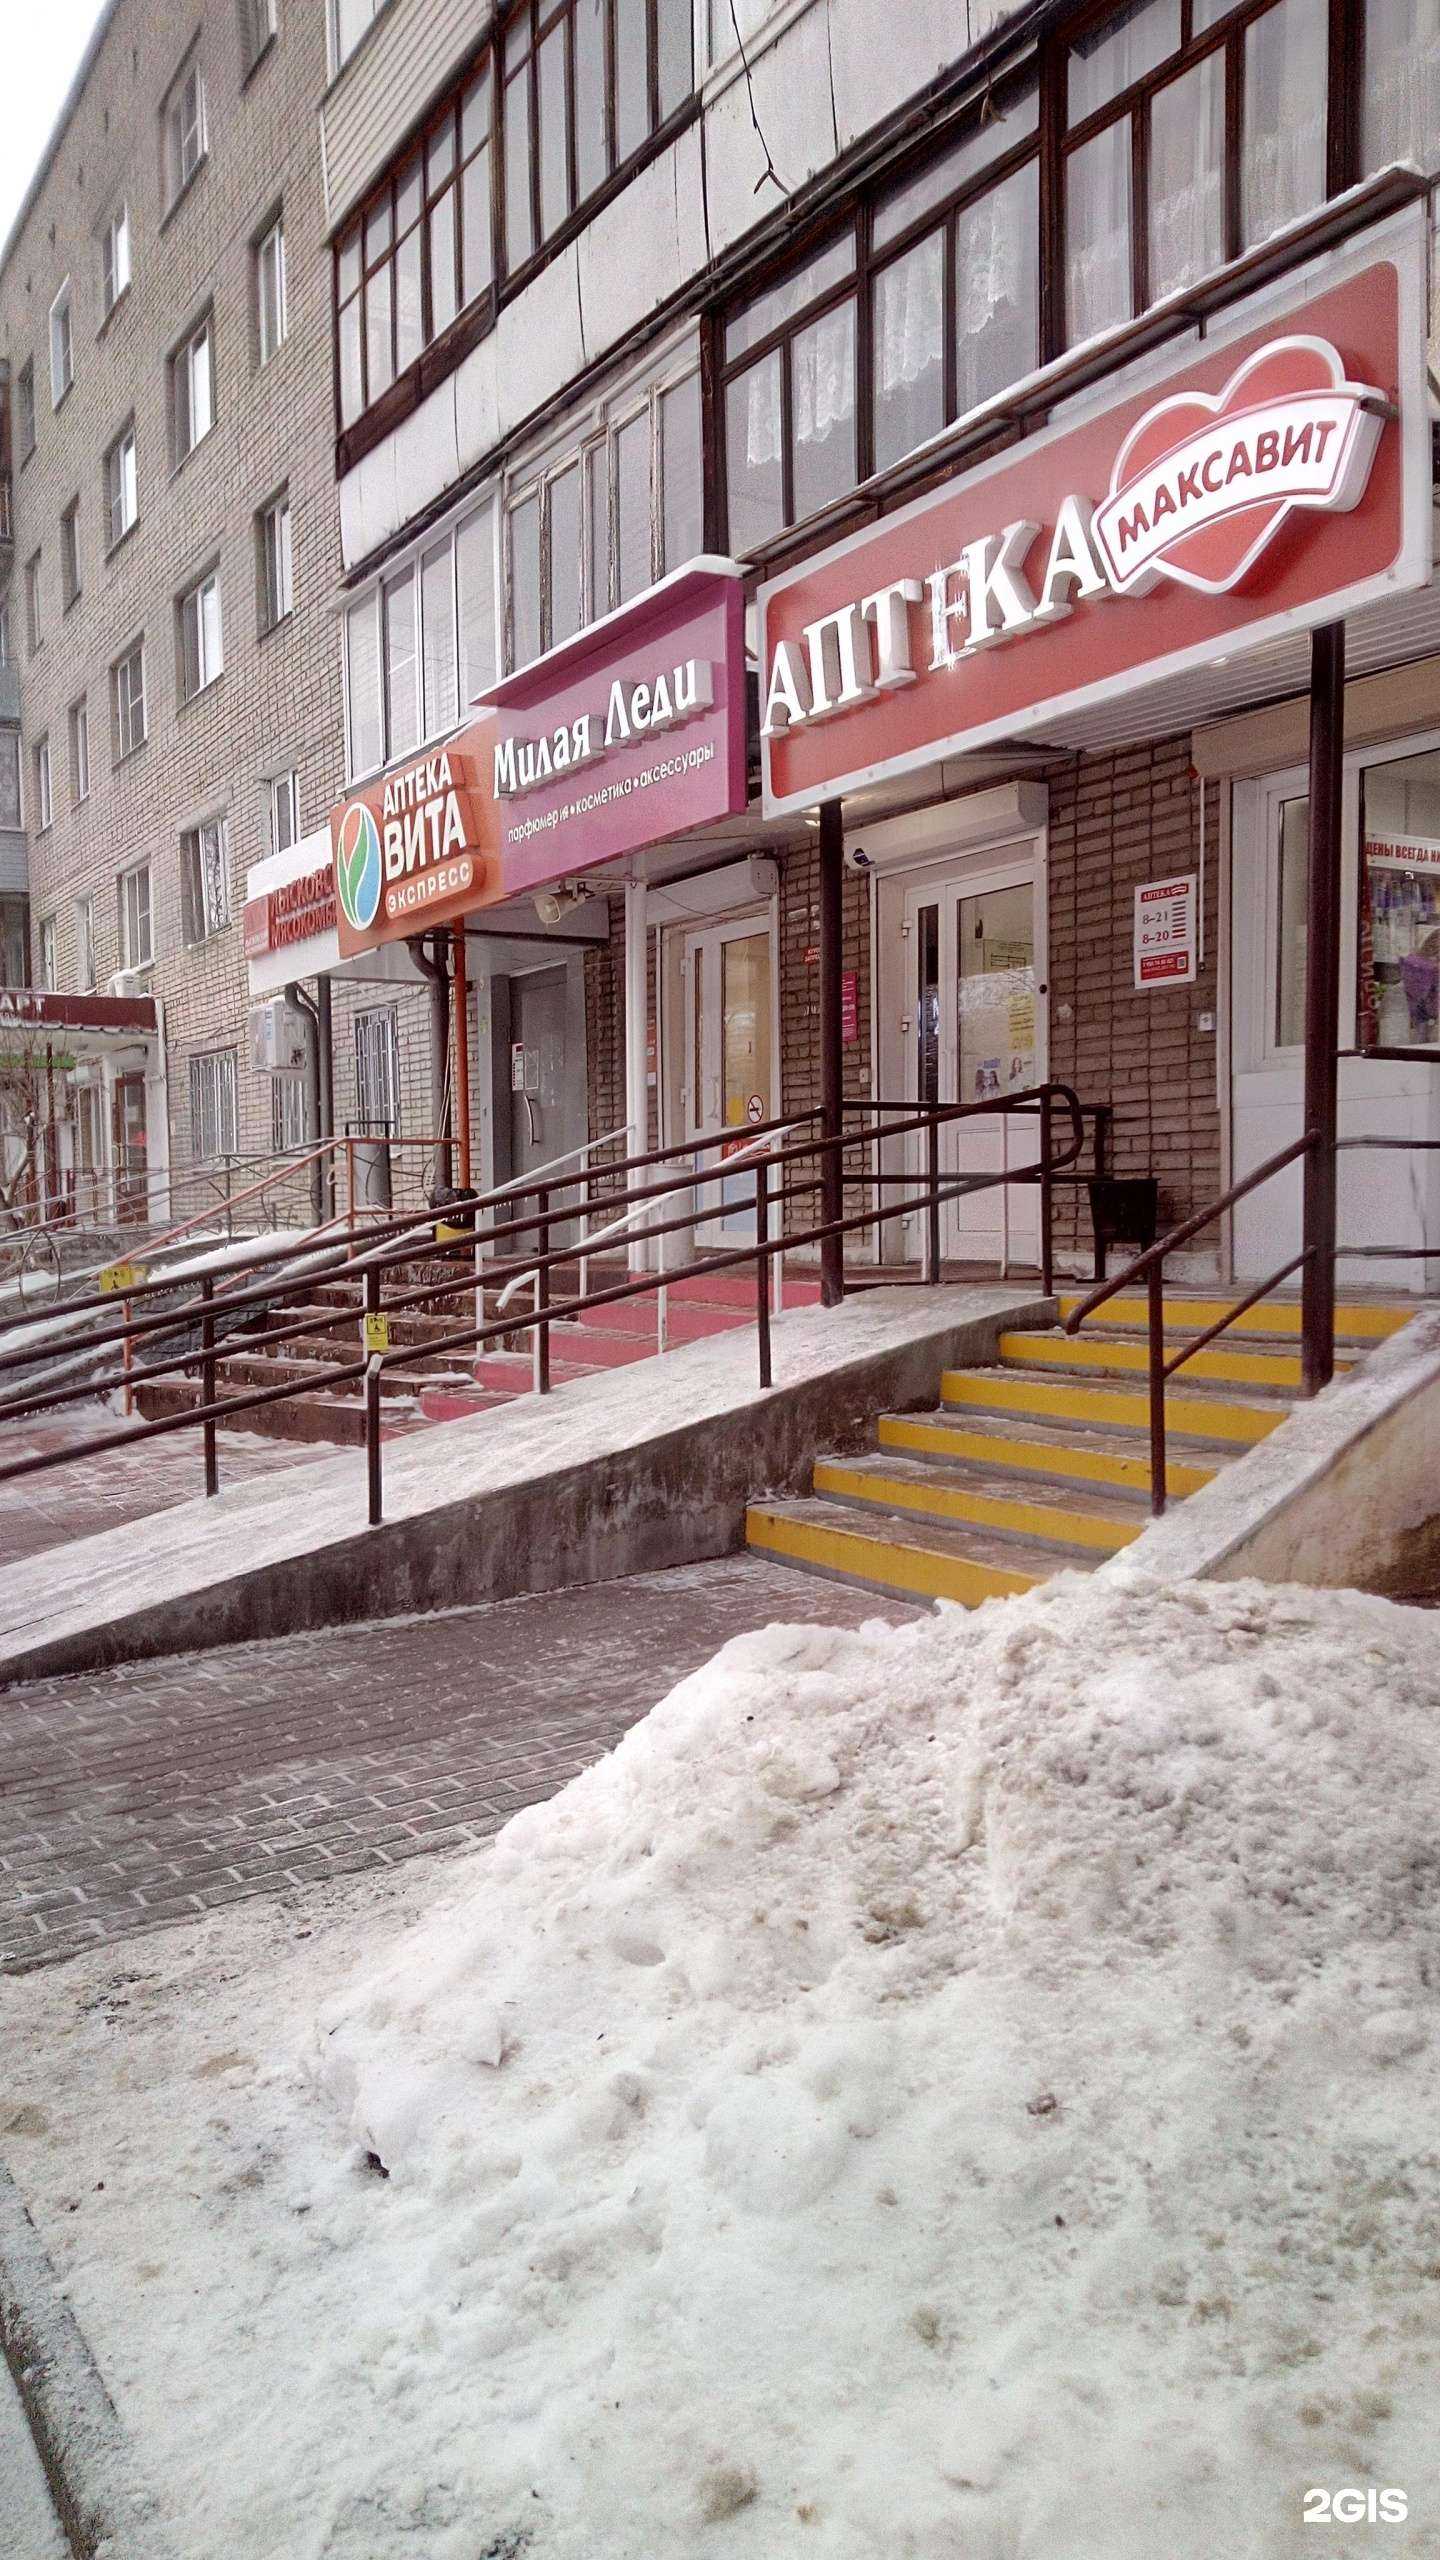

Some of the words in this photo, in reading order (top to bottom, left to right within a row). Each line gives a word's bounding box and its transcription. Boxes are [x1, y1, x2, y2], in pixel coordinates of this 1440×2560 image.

[1117, 420, 1337, 553] МАКСАВИТ
[760, 494, 1106, 737] АПТЕКА
[493, 714, 592, 800] Милая
[604, 659, 698, 746] Леди
[383, 752, 453, 820] АПТЕКА
[575, 778, 632, 816] косметика
[639, 741, 715, 788] аксессуары
[383, 790, 468, 881] ВИТА
[1395, 845, 1429, 863] ВСЕГДА
[388, 862, 470, 913] ЭКСПРЕСС
